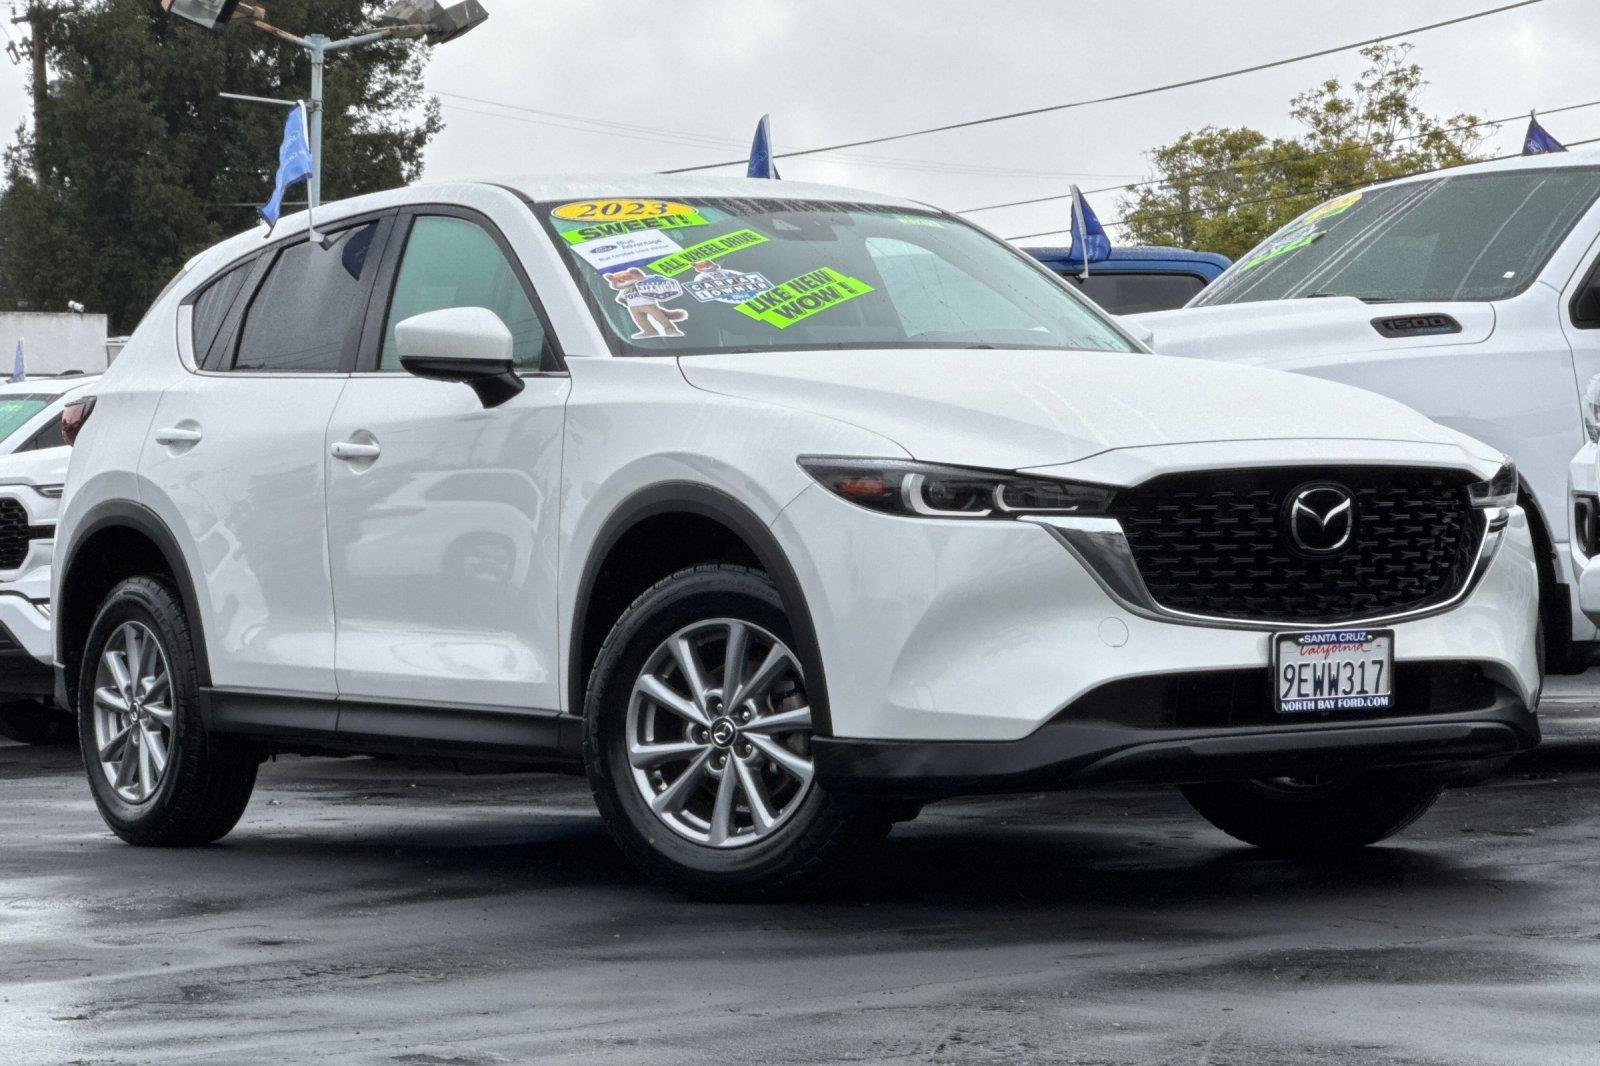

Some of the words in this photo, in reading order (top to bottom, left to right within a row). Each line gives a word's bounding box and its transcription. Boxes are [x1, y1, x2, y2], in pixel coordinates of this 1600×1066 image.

[576, 202, 668, 218] 2023
[577, 214, 690, 241] SWEET!
[657, 257, 687, 274] ALL
[679, 242, 729, 262] WHEEL
[718, 231, 762, 248] DRIVE
[690, 274, 765, 292] CARFAX
[711, 282, 769, 297] OWNER
[744, 287, 794, 315] LIKE
[785, 269, 838, 295] NEW
[772, 285, 844, 320] WOW
[1382, 317, 1447, 329] 1500
[1304, 632, 1337, 643] SANTA
[1339, 631, 1367, 642] CRUZ
[1299, 642, 1371, 660] California
[1281, 660, 1384, 699] 9EWW317
[1281, 700, 1315, 712] NORTH
[1318, 699, 1336, 709] BAY
[1338, 696, 1389, 707] FORD.COM
